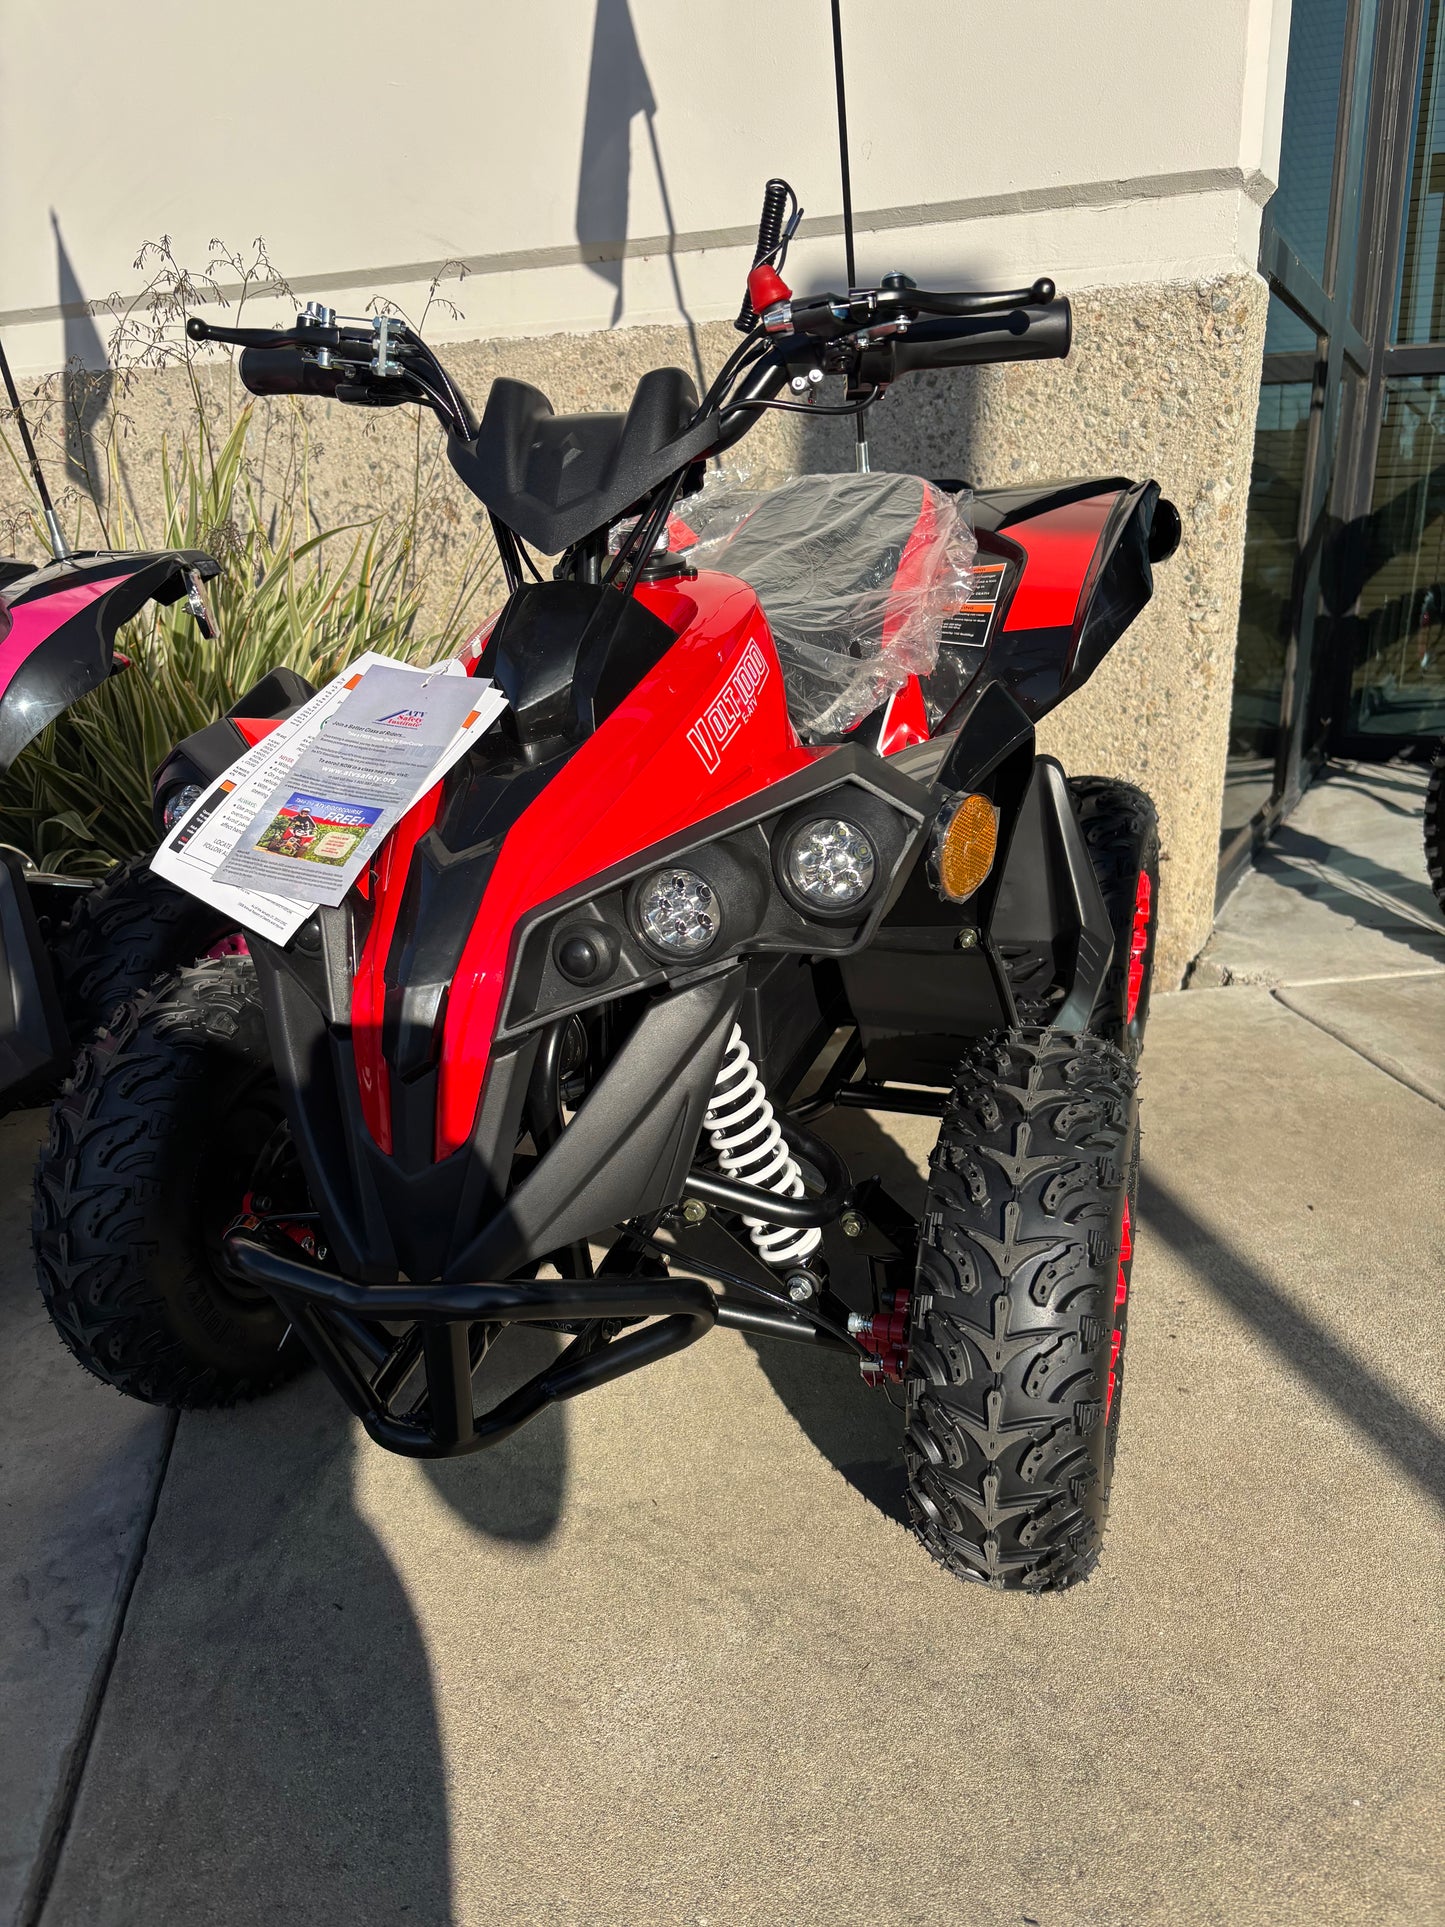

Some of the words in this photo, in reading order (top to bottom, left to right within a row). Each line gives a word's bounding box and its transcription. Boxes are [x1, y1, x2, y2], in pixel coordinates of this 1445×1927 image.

[686, 687, 741, 775] VOLT
[732, 644, 766, 705] 1000
[741, 694, 759, 725] E-ATV
[398, 714, 424, 723] Safety
[322, 766, 398, 784] www.atvsafety.org
[324, 811, 366, 825] FREE!
[203, 842, 222, 853] FOLLOW
[214, 839, 232, 849] LOCATE
